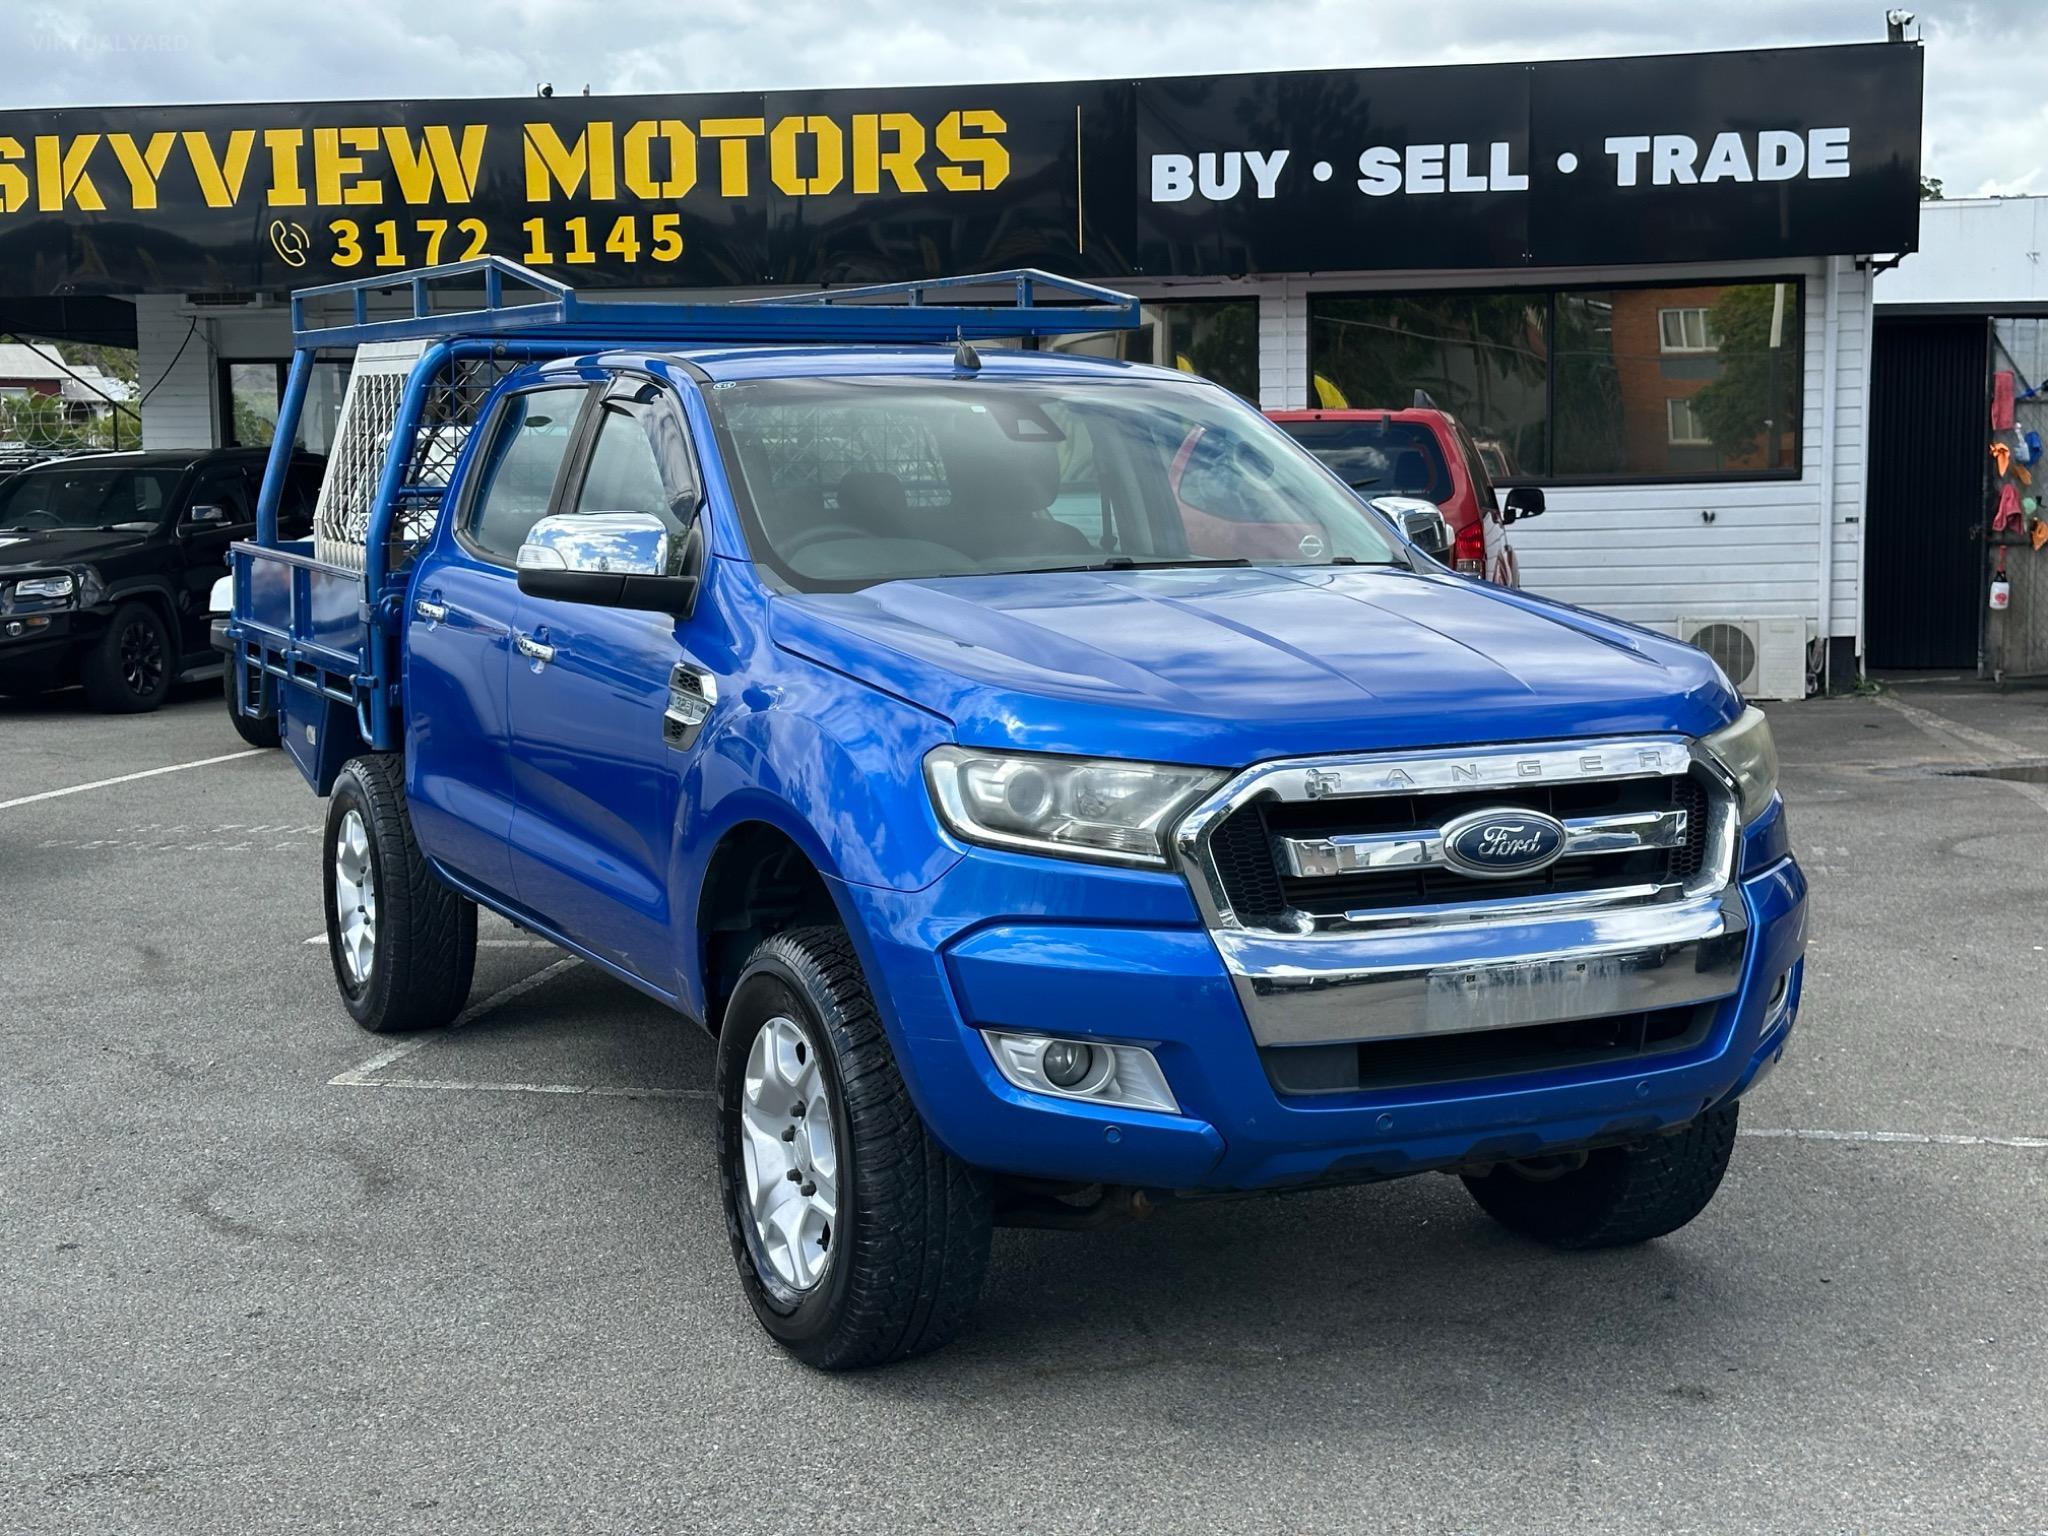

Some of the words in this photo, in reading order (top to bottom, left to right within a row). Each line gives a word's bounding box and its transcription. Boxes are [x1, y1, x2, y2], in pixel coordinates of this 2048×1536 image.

[523, 109, 1010, 202] MOTORS
[1151, 149, 1290, 203] BUY
[1357, 141, 1530, 197] SELL
[1604, 127, 1851, 187] TRADE
[329, 217, 488, 268] 3172
[522, 213, 684, 265] 1145
[1312, 751, 1663, 795] RANGER
[1476, 825, 1543, 856] Ford
